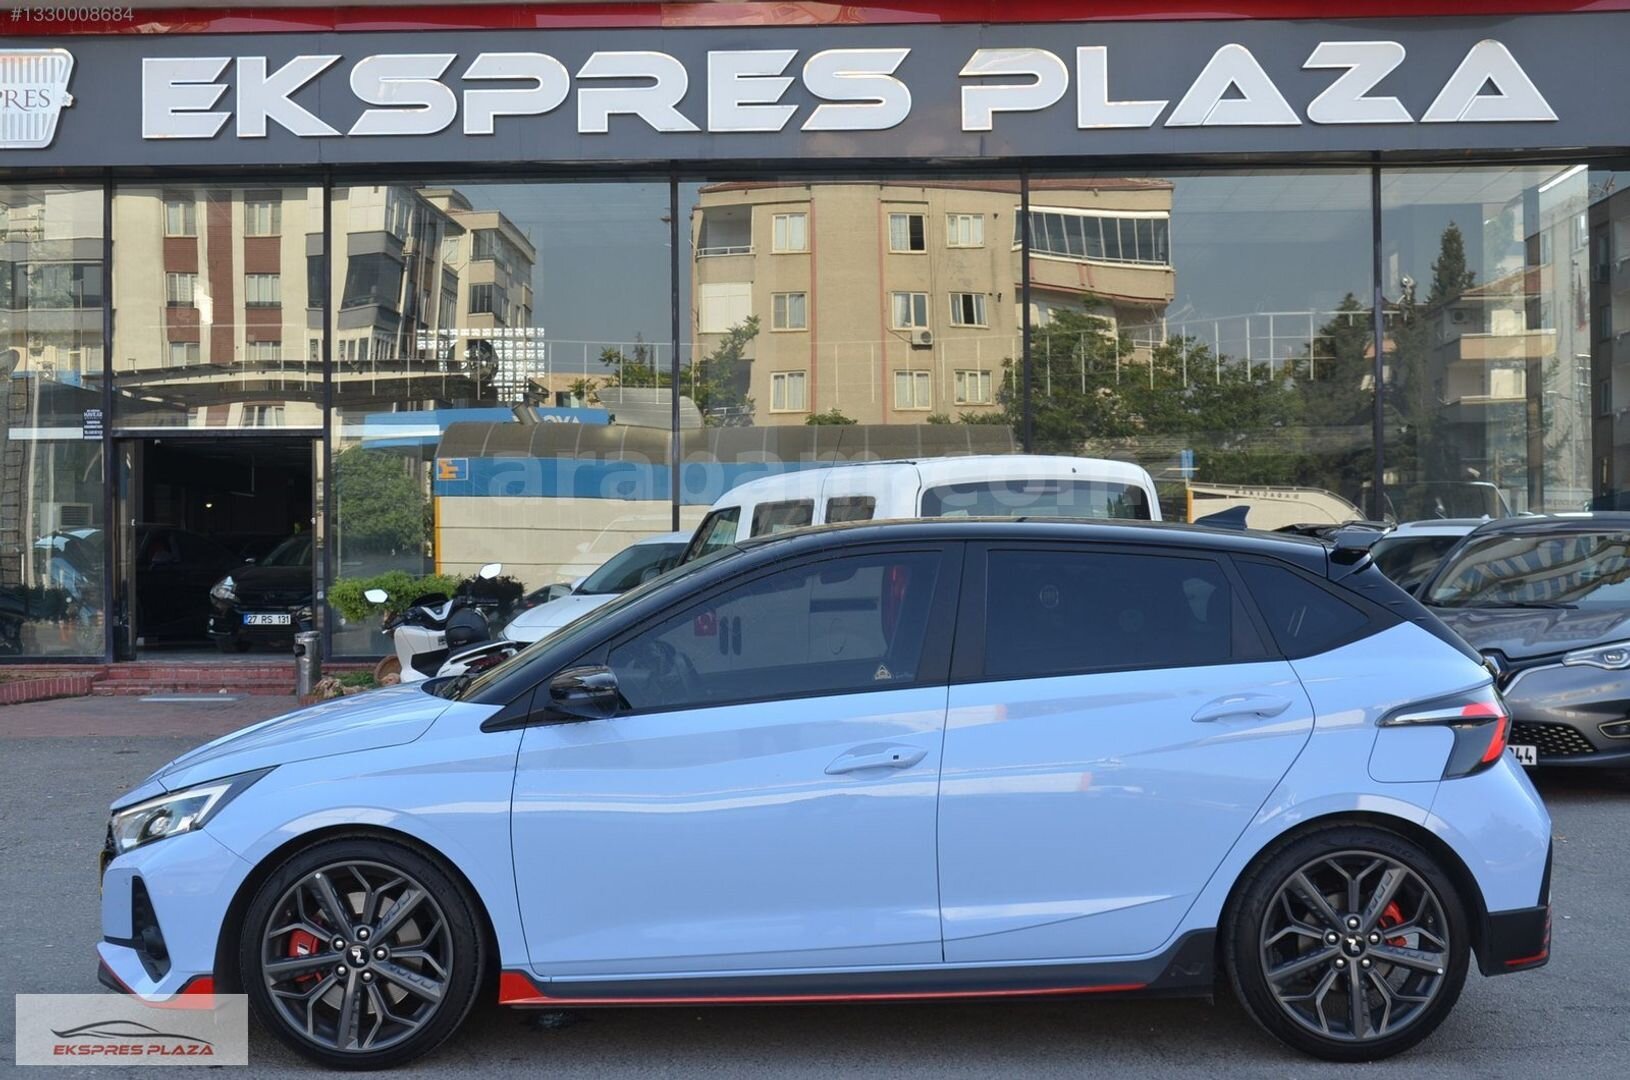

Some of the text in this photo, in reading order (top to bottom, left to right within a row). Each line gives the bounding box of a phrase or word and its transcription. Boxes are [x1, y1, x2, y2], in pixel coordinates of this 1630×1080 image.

[141, 39, 1559, 139] EKSPRES PLAZA
[0, 88, 51, 112] RES
[248, 615, 290, 624] 27 RS 131
[1509, 747, 1533, 763] 44
